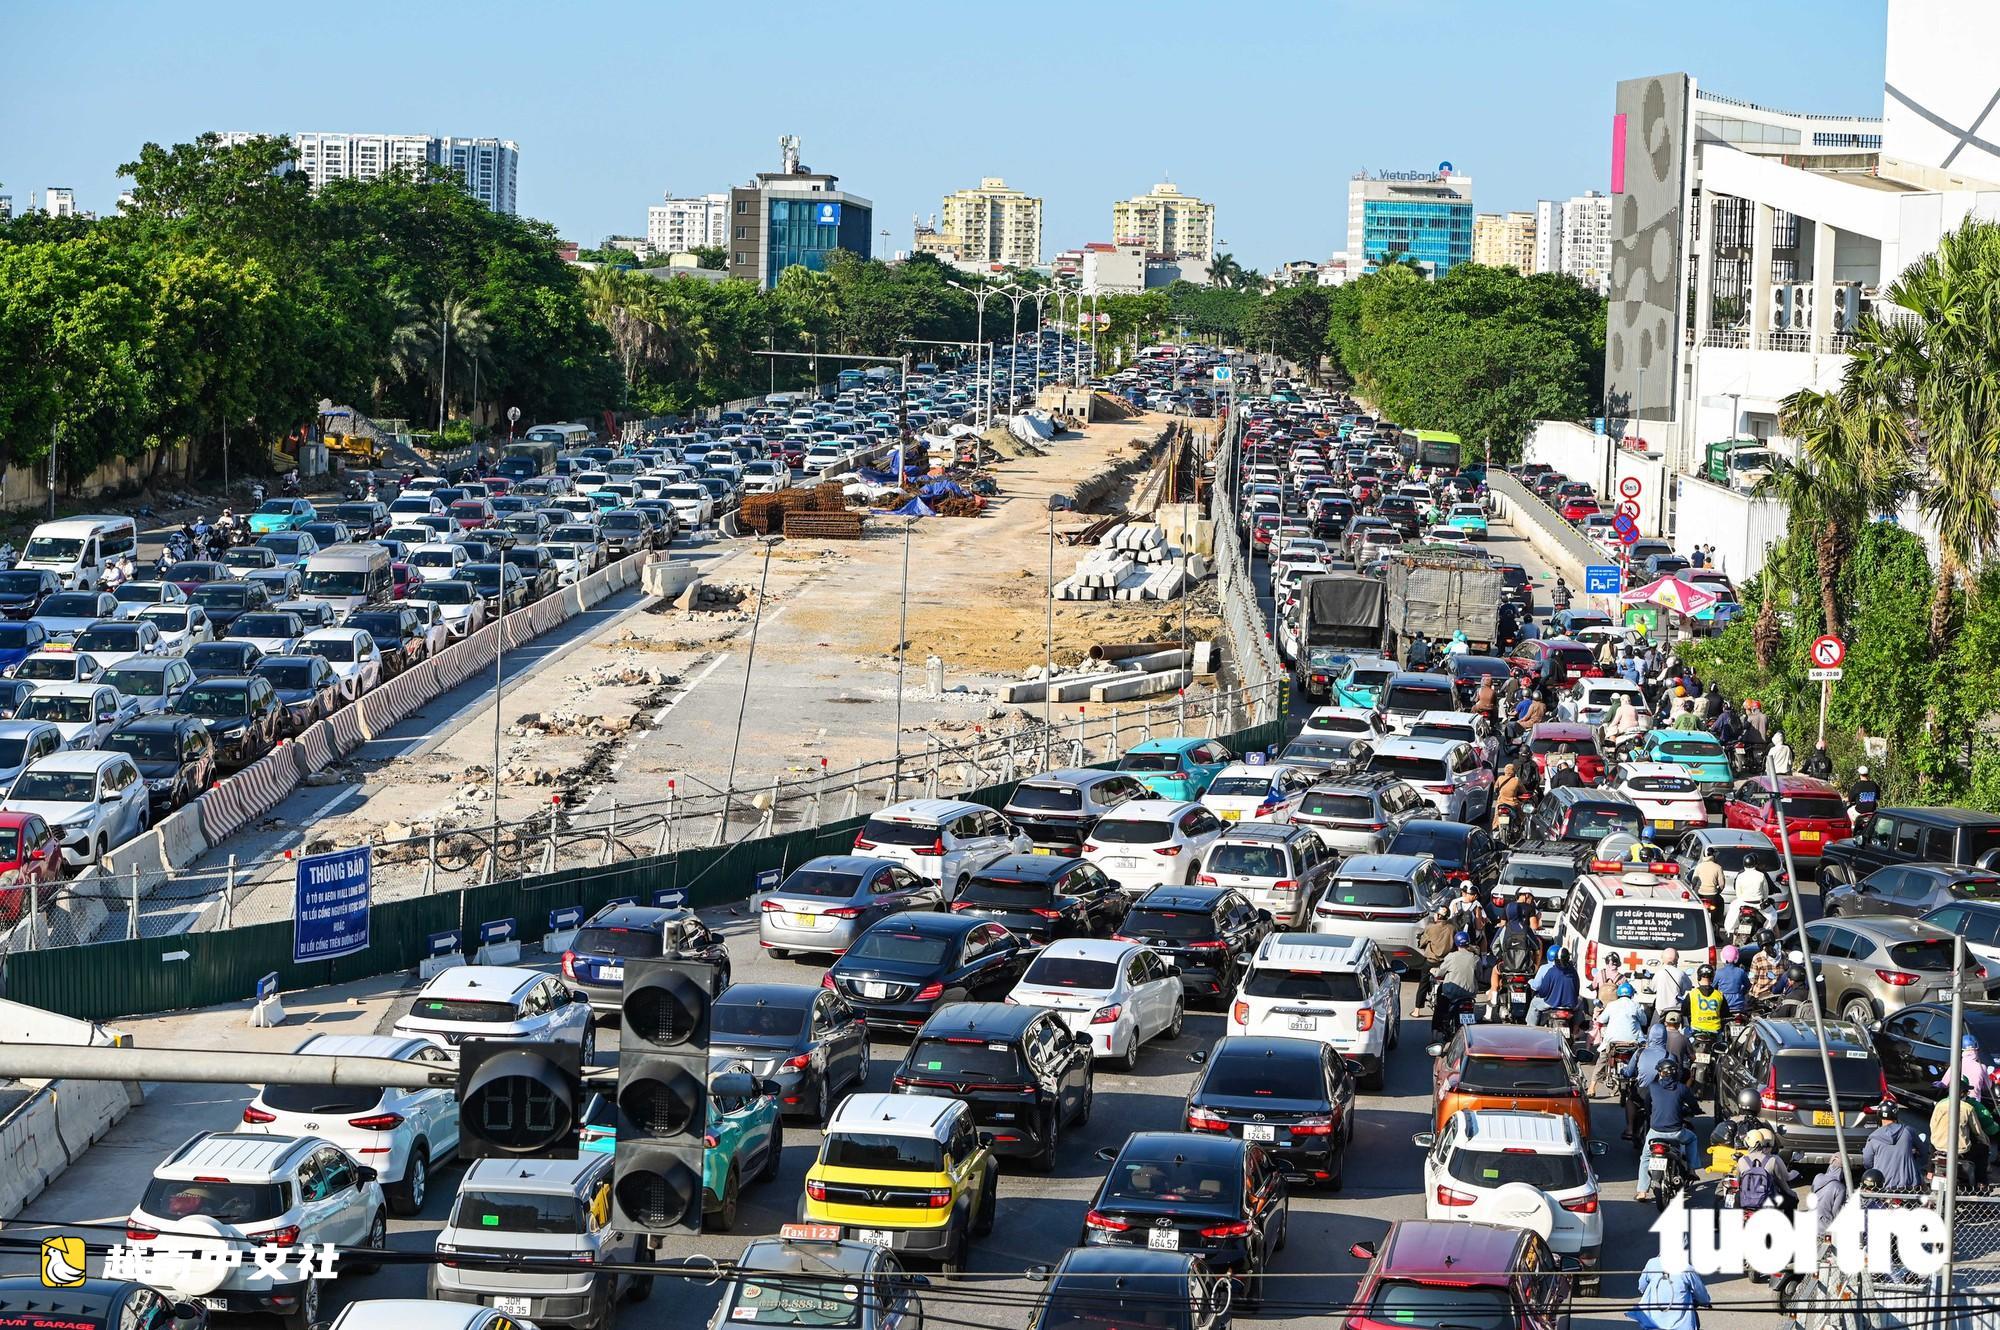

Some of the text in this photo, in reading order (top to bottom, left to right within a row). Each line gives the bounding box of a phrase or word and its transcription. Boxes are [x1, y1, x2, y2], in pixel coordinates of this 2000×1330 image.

[1380, 169, 1438, 181] VietinBank
[309, 856, 364, 885] THÔNG BÁO
[1658, 919, 1672, 927] NỘI
[1698, 994, 1718, 1011] be
[784, 1226, 838, 1238] Taxi 123
[1156, 1229, 1171, 1238] 30F
[1150, 1240, 1177, 1248] 464.57
[33, 1320, 96, 1330] GARAGE
